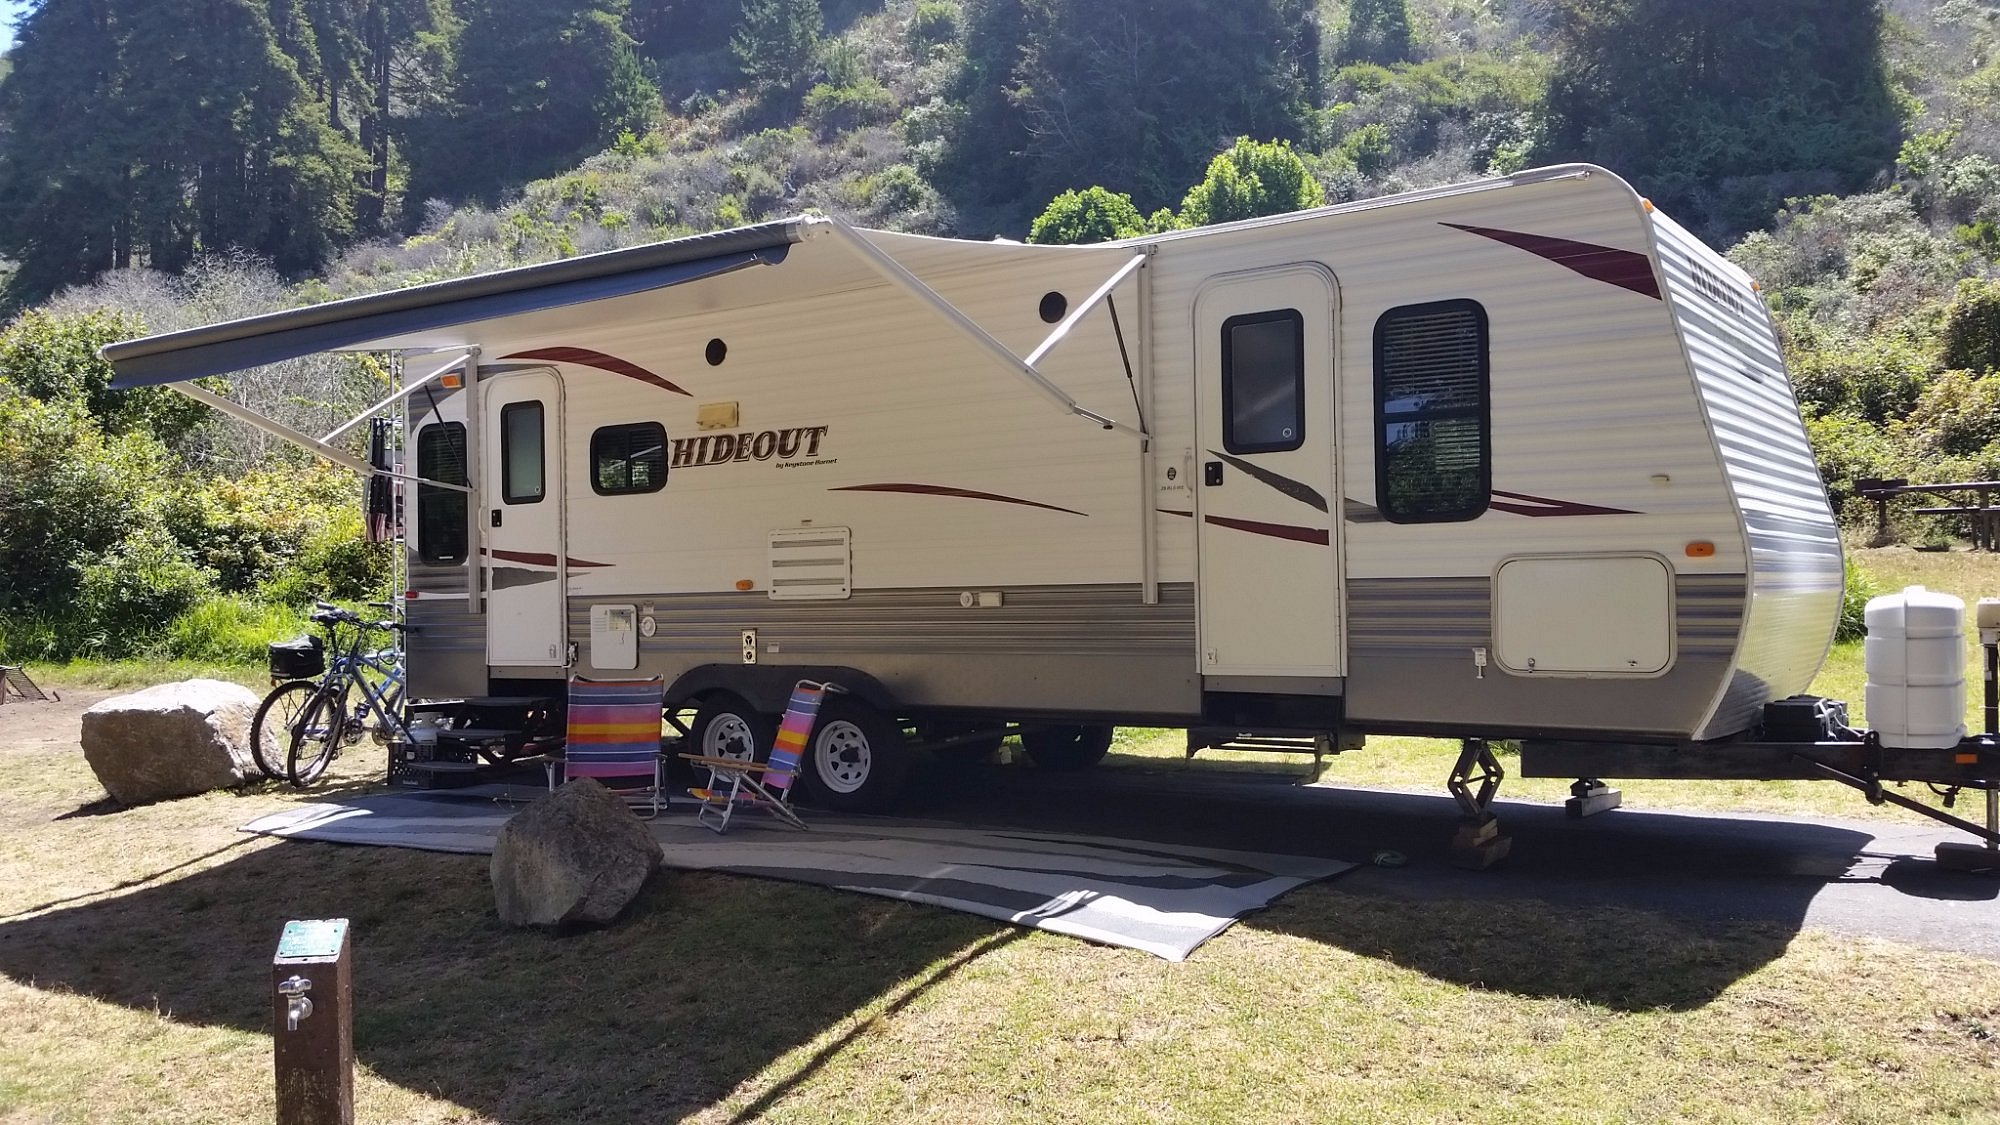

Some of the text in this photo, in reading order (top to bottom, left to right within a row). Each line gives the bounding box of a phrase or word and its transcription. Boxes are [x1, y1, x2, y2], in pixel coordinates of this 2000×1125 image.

[670, 425, 829, 469] HIDEOUT
[785, 460, 815, 468] Keystone
[814, 458, 838, 466] Hornet
